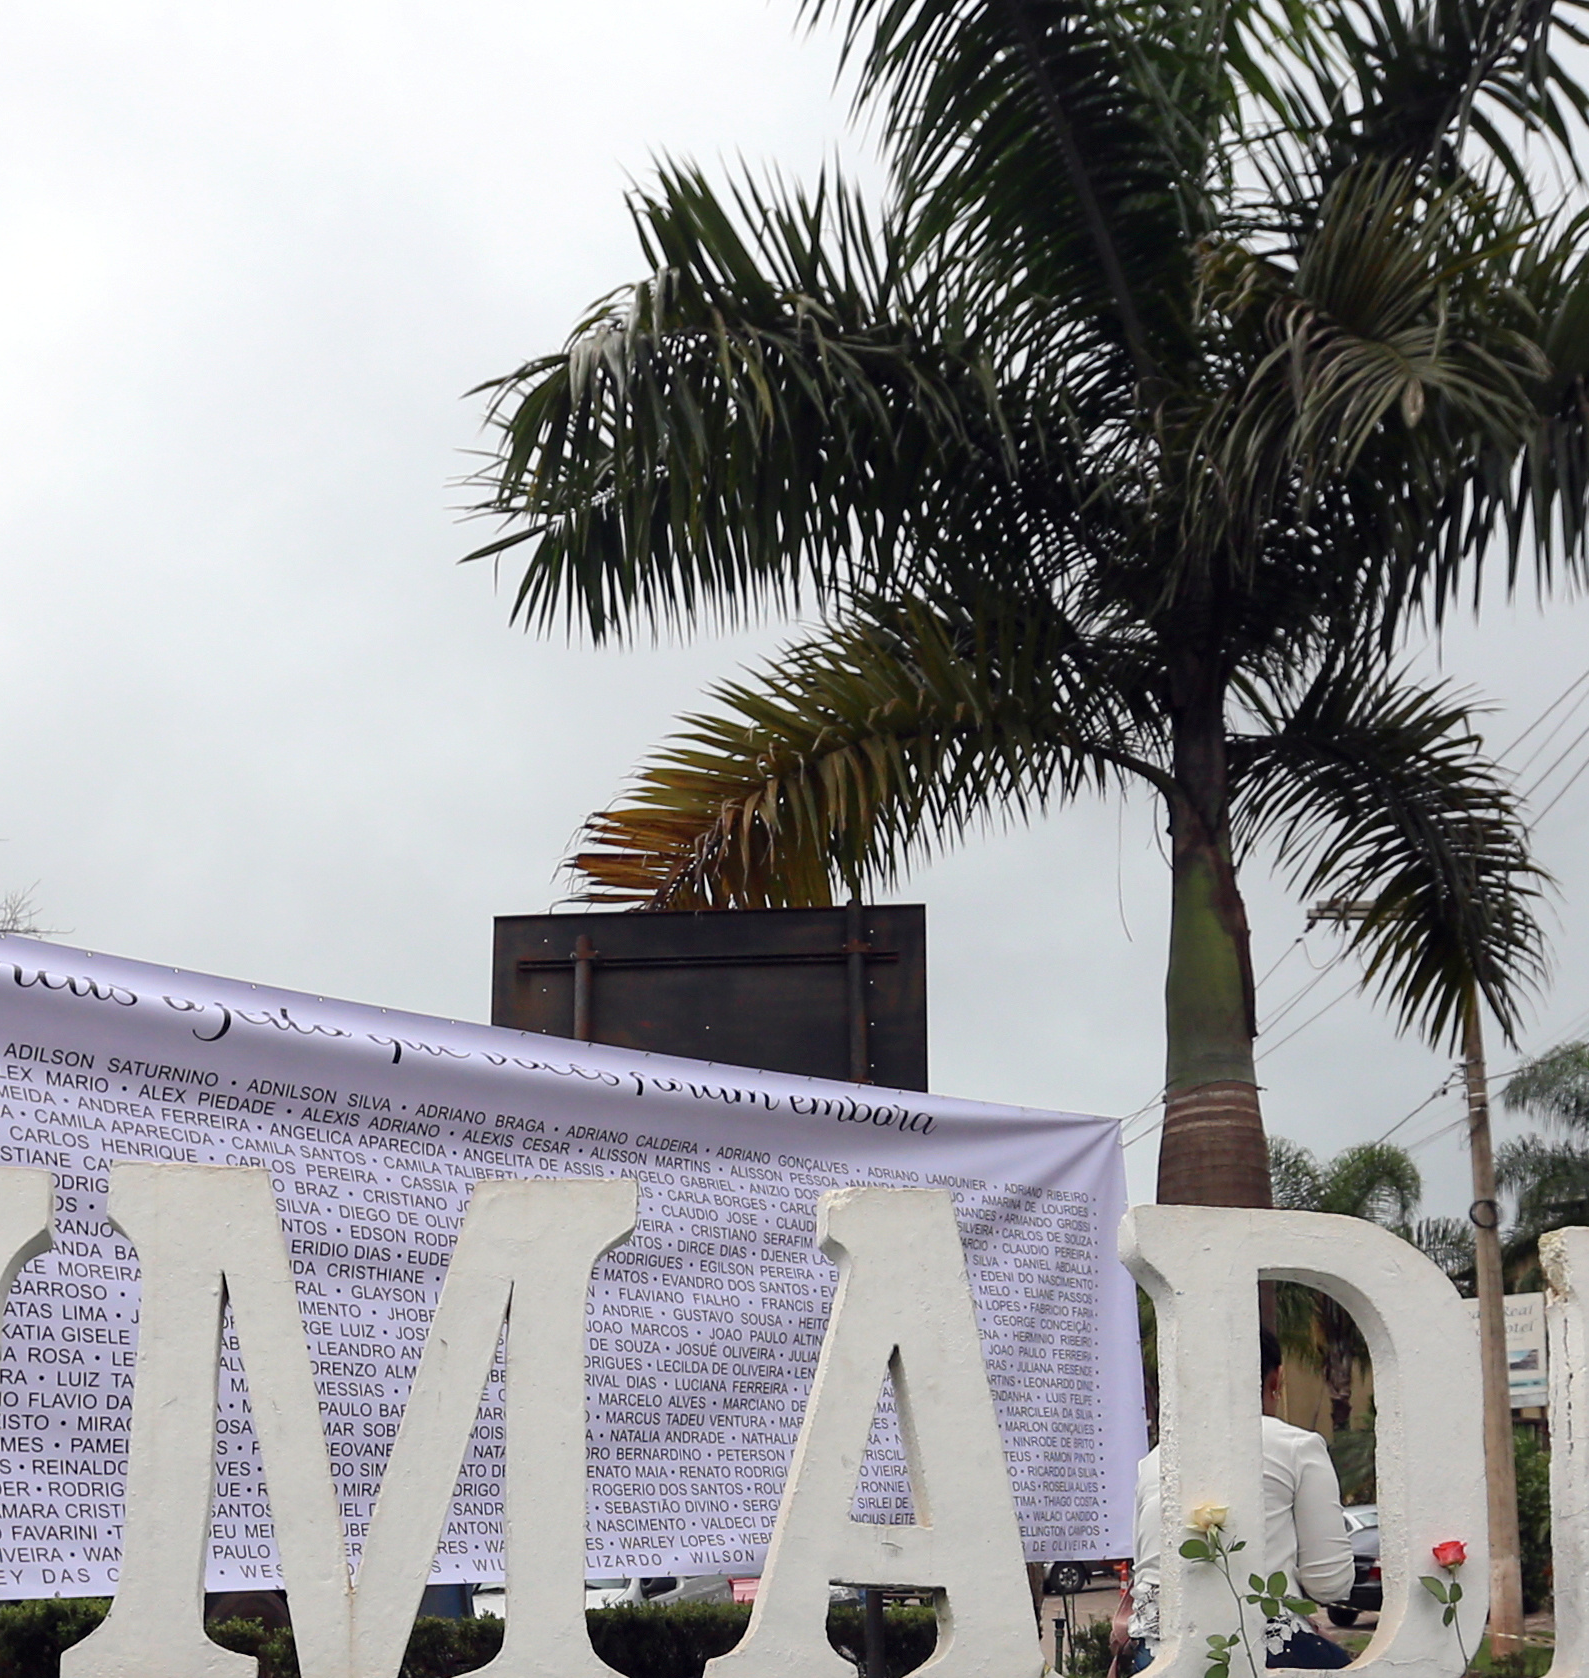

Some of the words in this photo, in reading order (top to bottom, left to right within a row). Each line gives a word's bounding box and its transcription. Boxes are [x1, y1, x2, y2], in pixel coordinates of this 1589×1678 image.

[3, 1042, 95, 1070] ADILSON
[107, 1057, 219, 1087] SATURNINO
[246, 1079, 337, 1105] ADNILSON
[347, 1093, 391, 1113] SILVA
[414, 1103, 486, 1125] ADRIANO
[494, 1114, 545, 1134] BRAGA
[565, 1125, 628, 1145] ADRIANO
[635, 1135, 698, 1155] CALDEIRA
[715, 1146, 771, 1165] ADRIANO
[778, 1154, 849, 1175] GONÇALVES
[868, 1167, 919, 1182] ADRIANO
[925, 1174, 987, 1191] LAMOUNIER
[1005, 1183, 1043, 1199] ADRIANO
[1046, 1188, 1089, 1203] RIBEIRO
[46, 1070, 109, 1093] MARIO
[138, 1084, 187, 1104] ALEX
[198, 1091, 277, 1116] PIEDADE
[300, 1107, 361, 1127] ALEXIS
[367, 1116, 440, 1138] ADRIANO
[462, 1129, 515, 1148] ALEXIS
[522, 1137, 571, 1155] CESAR
[589, 1146, 647, 1165] ALISSON
[655, 1155, 711, 1174] MARTINS
[730, 1165, 783, 1182] ALISSON
[789, 1172, 839, 1188] PESSOA
[787, 1093, 939, 1137] embora
[34, 1109, 107, 1132] CAMILA
[111, 1120, 215, 1146] APARECIDA
[231, 1136, 296, 1156] CAMILA
[300, 1145, 367, 1165] SANTOS
[383, 1156, 440, 1174] CAMILA
[667, 1191, 712, 1208] CARLA
[714, 1195, 768, 1211] BORGES
[1002, 1228, 1043, 1241] CARLOS
[1046, 1231, 1061, 1243] DE
[1064, 1233, 1093, 1247] SOUZA
[78, 1096, 155, 1120] ANDREA
[161, 1108, 251, 1133] FERREIRA
[270, 1122, 354, 1146] ANGELICA
[358, 1134, 447, 1158] APARECIDA
[463, 1148, 535, 1169] ANGELITA
[539, 1157, 559, 1172] DE
[564, 1161, 604, 1177] ASSIS
[620, 1168, 675, 1185] ANGELO
[680, 1175, 735, 1192] GABRIEL
[749, 1183, 790, 1198] ANIZIO
[794, 1188, 820, 1200] DOS
[1003, 1212, 1053, 1229] ARMANDO
[1056, 1217, 1091, 1232] GROSSI
[10, 1126, 90, 1149] CARLOS
[101, 1137, 198, 1163] HENRIQUE
[306, 1163, 378, 1185] PEREIRA
[401, 1175, 458, 1194] CASSIA
[661, 1204, 718, 1222] CLAUDIO
[726, 1212, 758, 1226] JOSE
[1002, 1243, 1049, 1256] CLAUDIO
[1055, 1246, 1091, 1261] PEREIRA
[294, 1181, 339, 1199] BRAZ
[363, 1189, 447, 1211] CRISTIANO
[691, 1224, 757, 1243] CRISTIANO
[762, 1231, 814, 1249] SERAFIM
[291, 1239, 349, 1258] ERIDIO
[354, 1245, 391, 1262] DIAS
[327, 1262, 425, 1285] CRISTHIANE
[673, 1308, 734, 1324] GUSTAVO
[740, 1312, 783, 1327] SOUSA
[61, 1326, 131, 1346] GISELE
[599, 1392, 662, 1408] MARCELO
[667, 1395, 706, 1410] ALVES
[604, 1498, 680, 1514] SEBASTIÃO
[685, 1500, 729, 1513] DIVINO
[688, 1549, 756, 1565] WILSON
